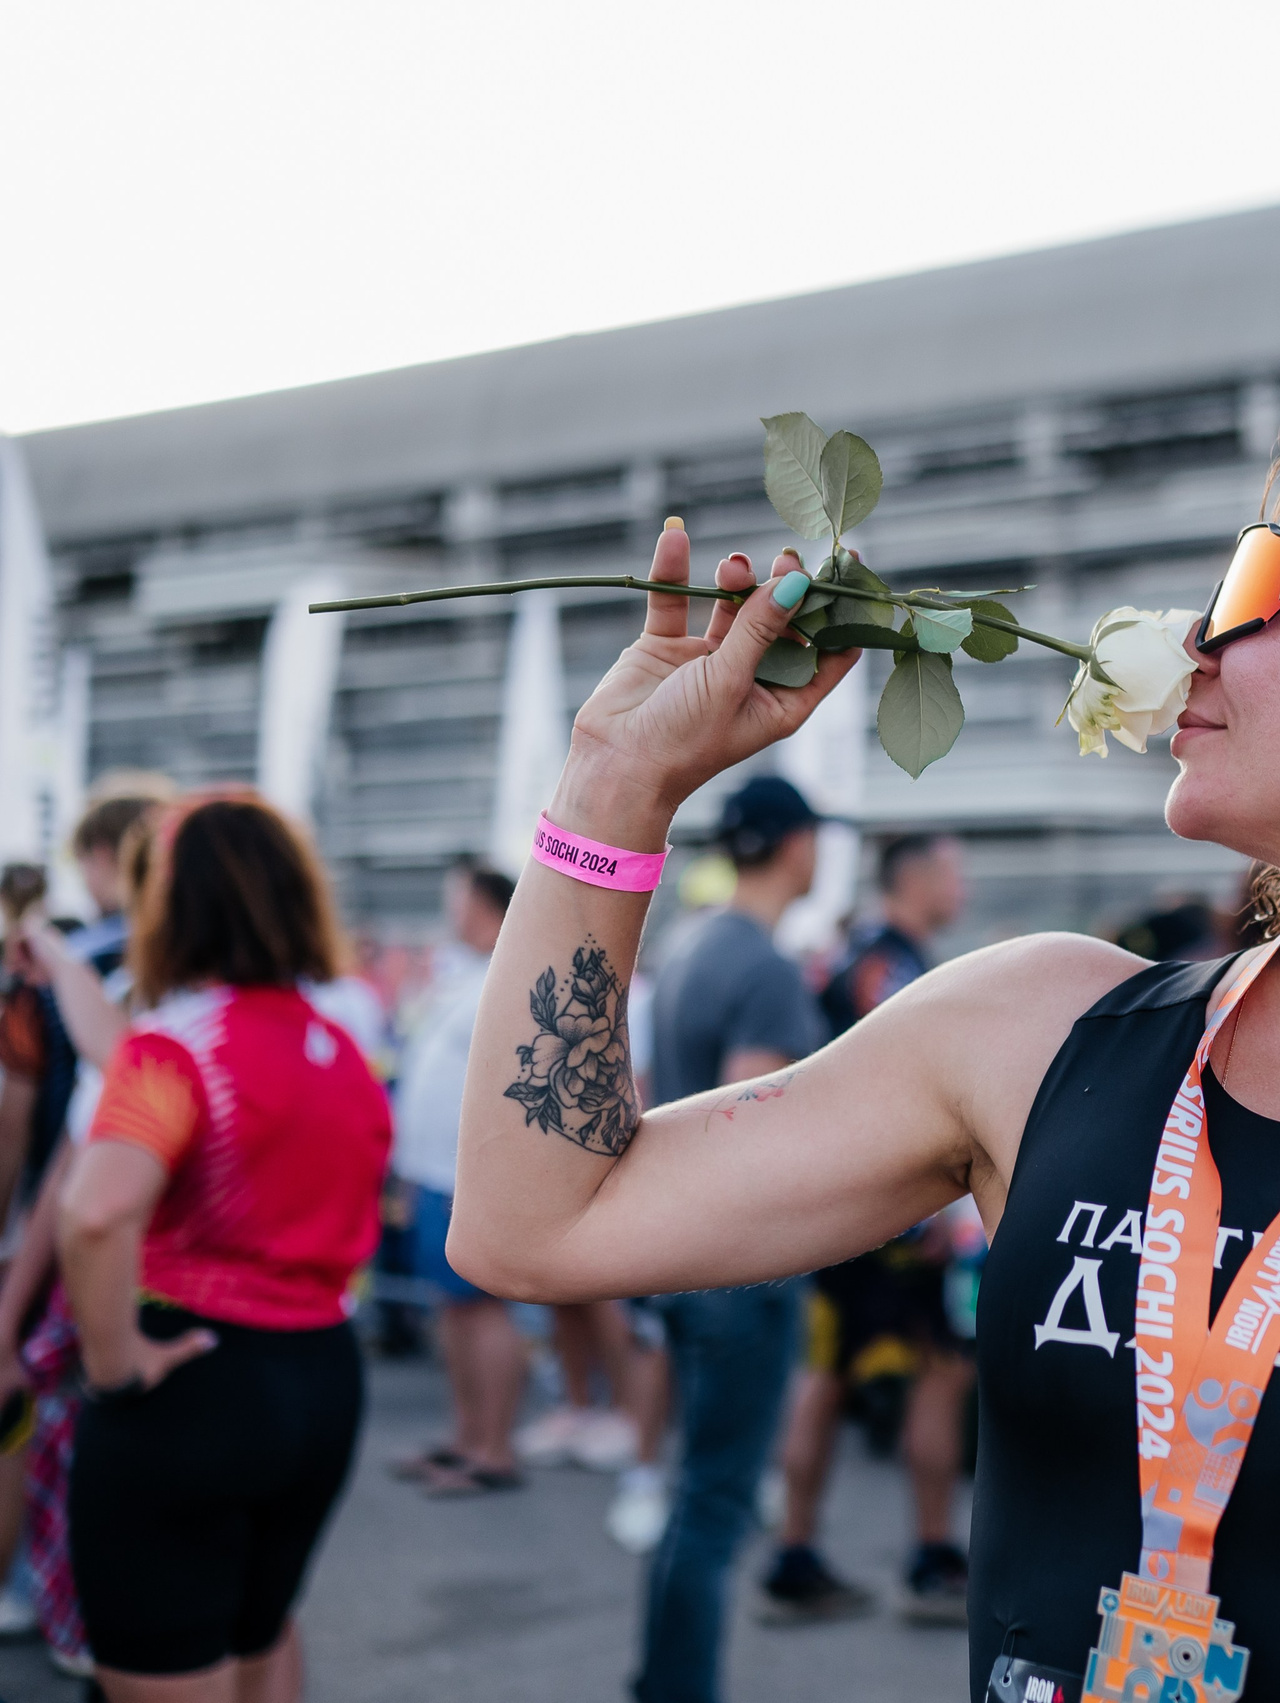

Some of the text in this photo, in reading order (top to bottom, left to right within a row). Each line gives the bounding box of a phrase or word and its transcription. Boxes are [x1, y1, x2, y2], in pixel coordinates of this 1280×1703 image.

[545, 836, 580, 864] SOCHI
[580, 851, 618, 876] 2024
[1135, 1073, 1205, 1460] SIRIUS SOCHI 2024
[1225, 1298, 1267, 1351] IRON
[1024, 1675, 1056, 1703] IRON
